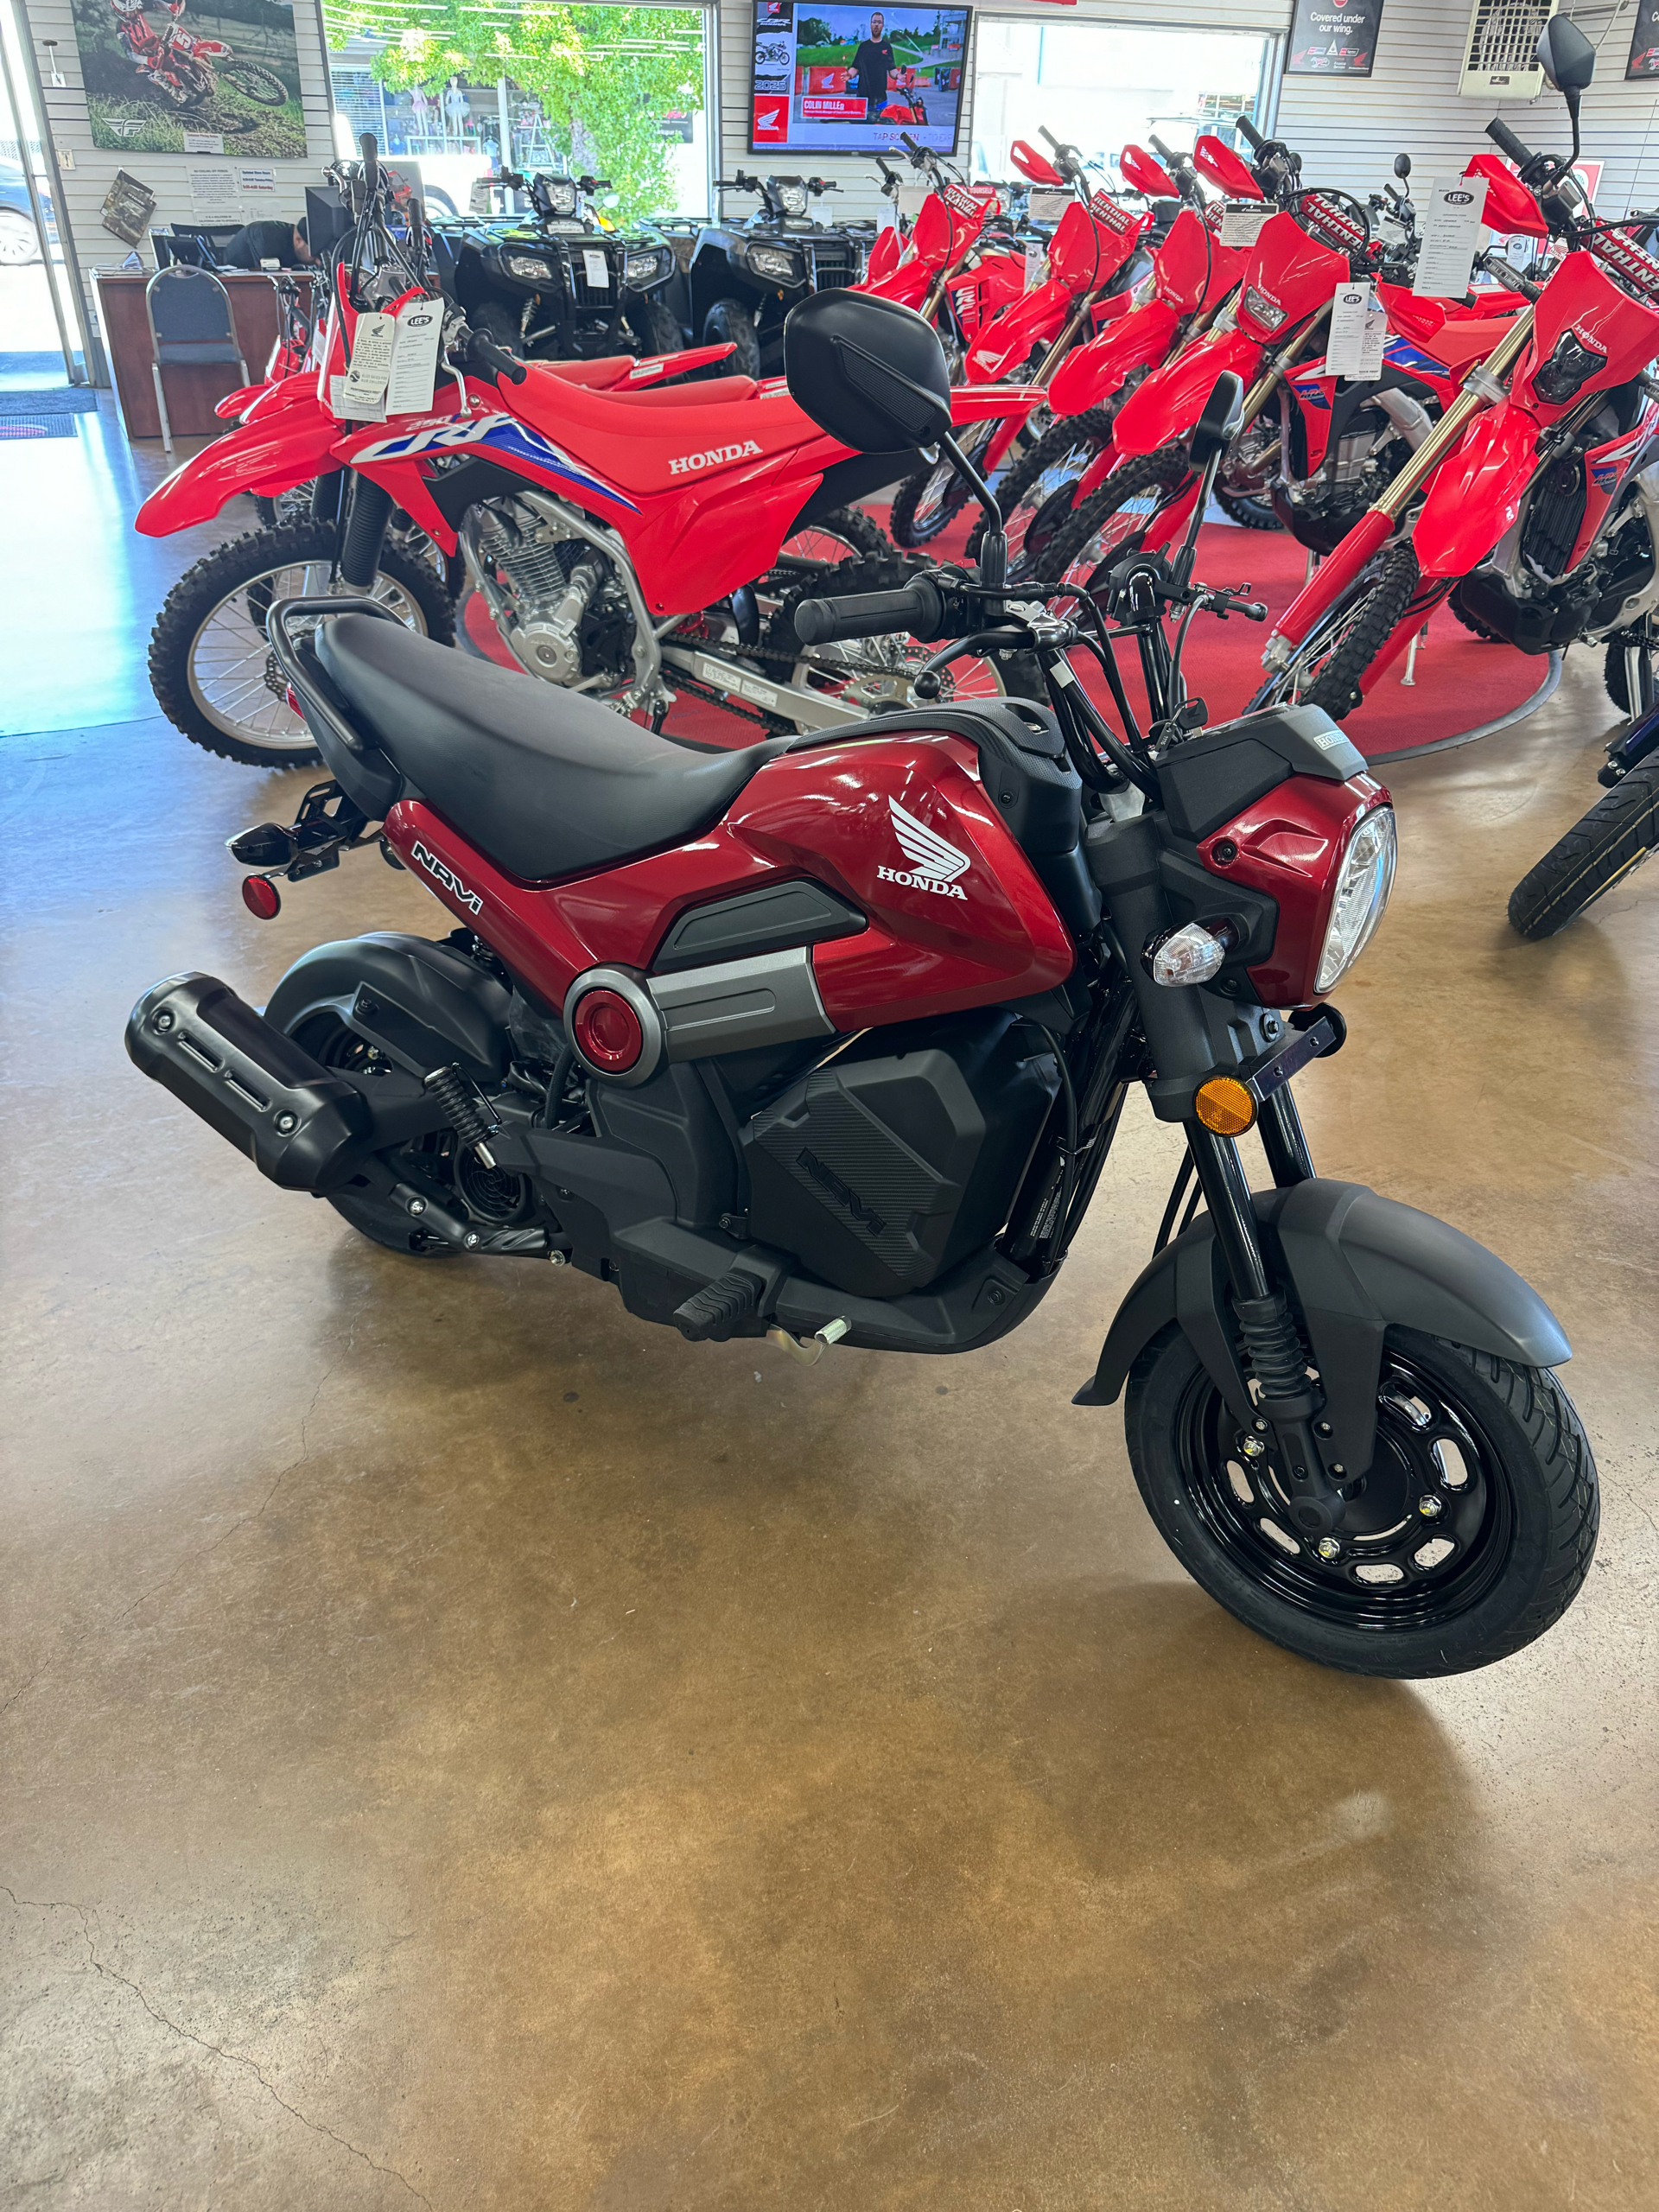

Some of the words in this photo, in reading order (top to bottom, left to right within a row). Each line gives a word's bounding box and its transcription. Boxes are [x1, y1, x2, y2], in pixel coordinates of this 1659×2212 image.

[1310, 11, 1343, 22] Covered
[1343, 13, 1365, 24] under
[1319, 23, 1332, 32] our
[1333, 23, 1353, 35] wing.
[753, 79, 787, 92] 2025
[804, 100, 822, 109] COLIN
[1094, 196, 1131, 226] RENTHAL
[1447, 194, 1471, 202] LEE'S
[1090, 203, 1126, 233] RENTHAL
[1592, 232, 1659, 290] ENTHAL
[1257, 282, 1281, 306] HONDA
[410, 316, 430, 325] LEE'S
[1573, 324, 1608, 354] HONDA
[349, 412, 518, 464] CRF
[668, 440, 764, 475] HONDA
[876, 865, 969, 901] HONDA
